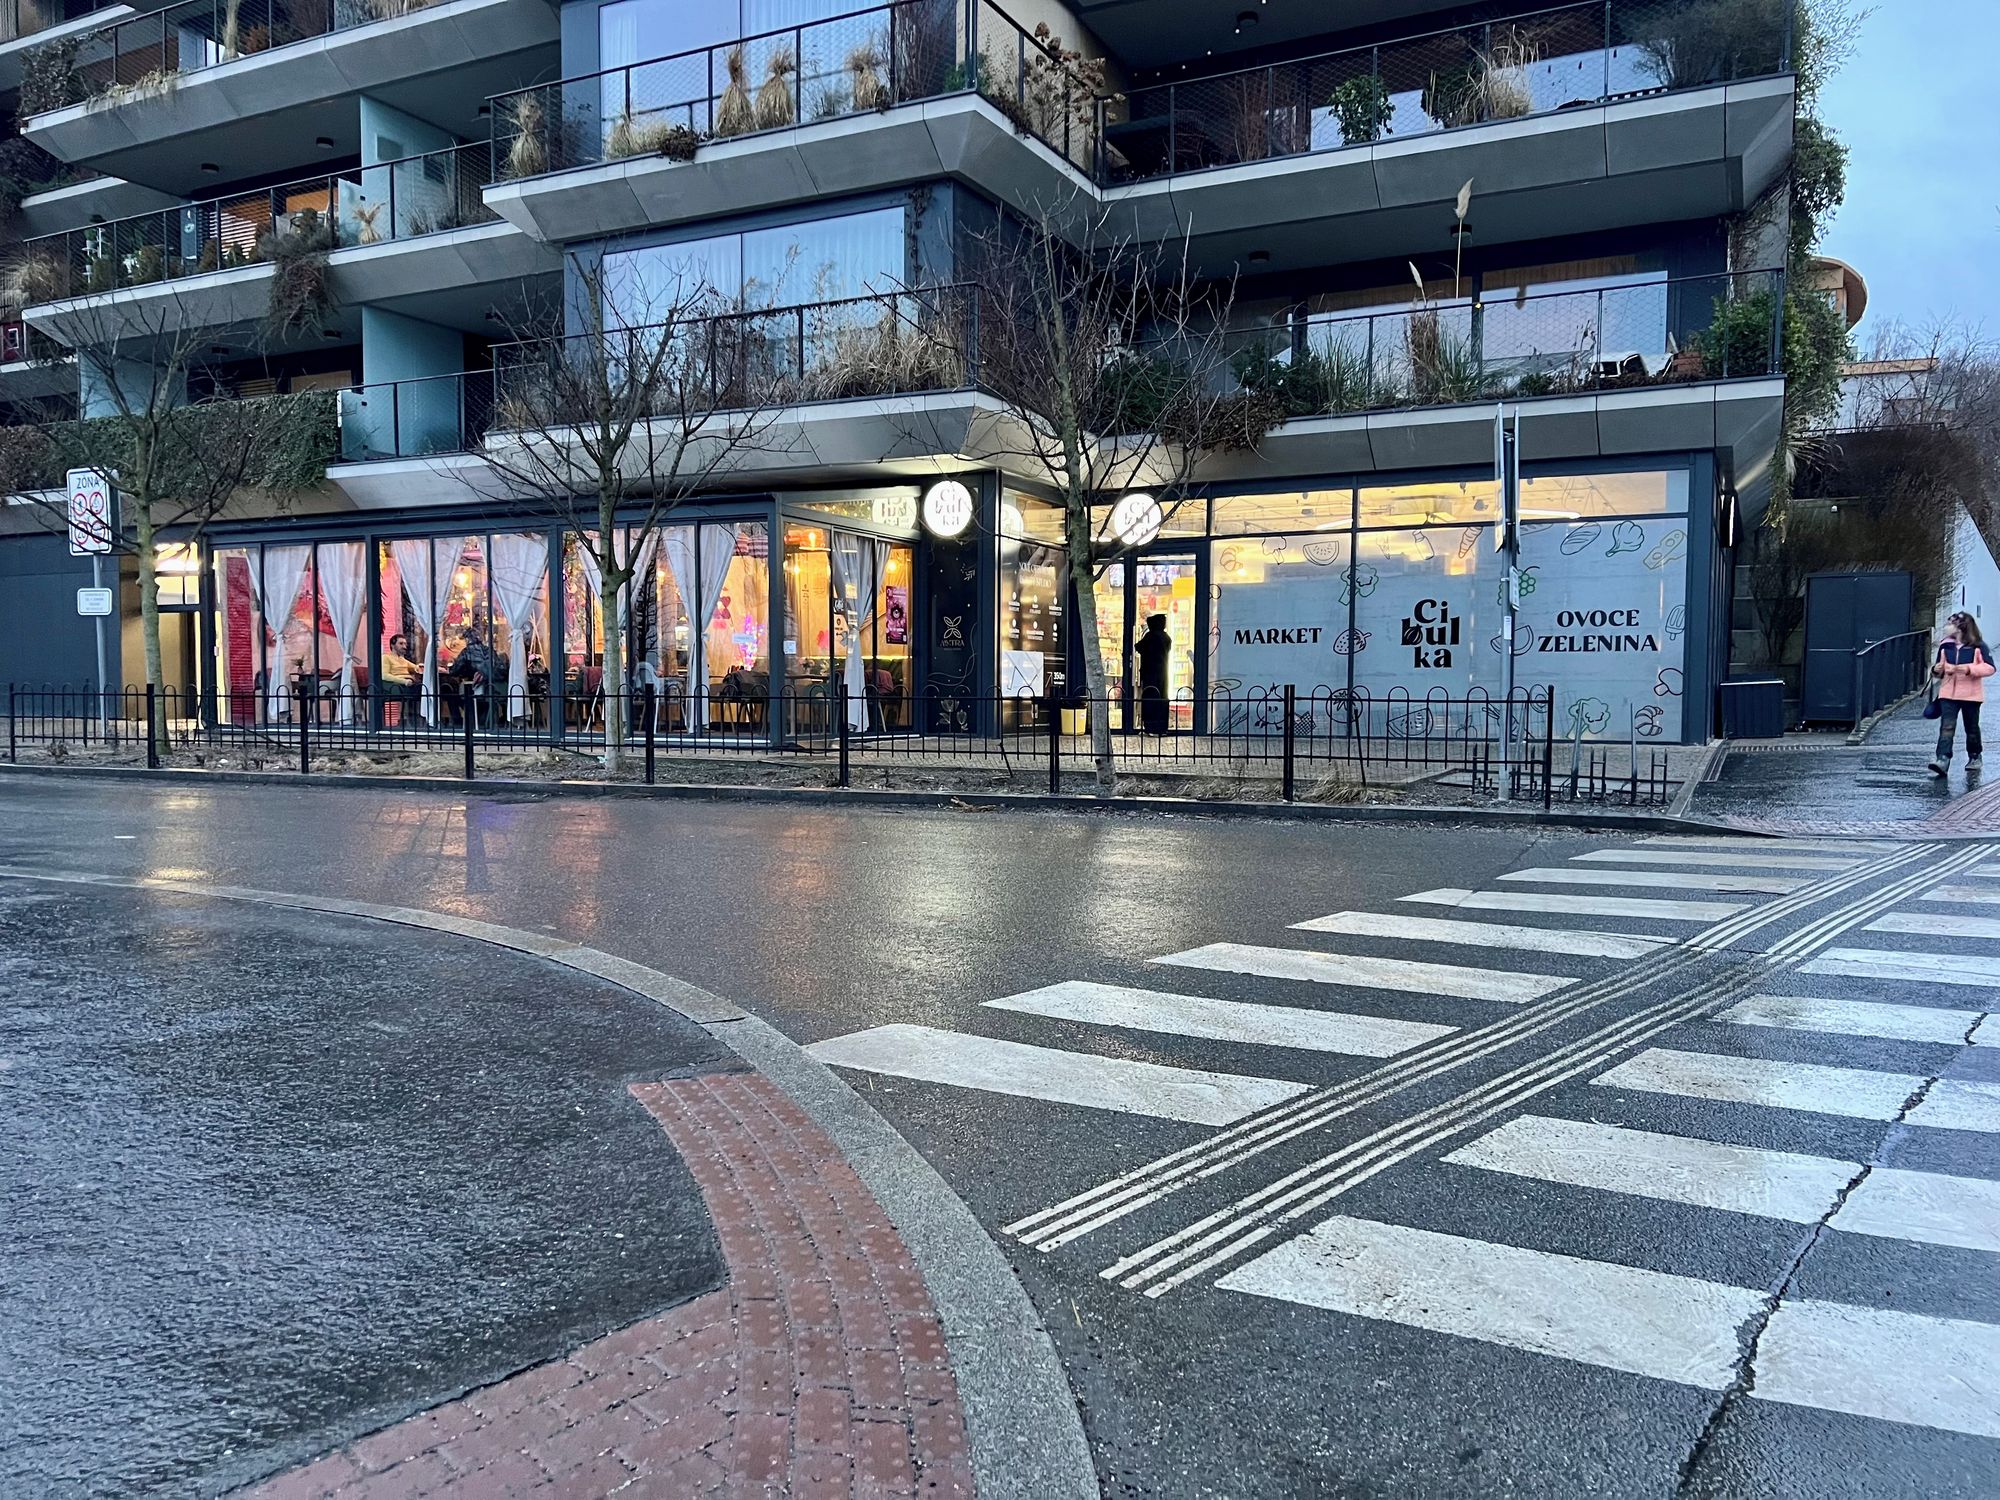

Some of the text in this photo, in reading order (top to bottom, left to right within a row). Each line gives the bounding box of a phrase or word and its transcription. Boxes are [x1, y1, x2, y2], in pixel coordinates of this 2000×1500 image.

[940, 488, 956, 502] Ci
[1414, 599, 1448, 623] Ci
[1557, 609, 1640, 627] OVOCE
[1234, 628, 1322, 644] MARKET
[1401, 616, 1460, 645] bul
[1538, 634, 1658, 652] ZELENINA
[1414, 646, 1452, 668] ka
